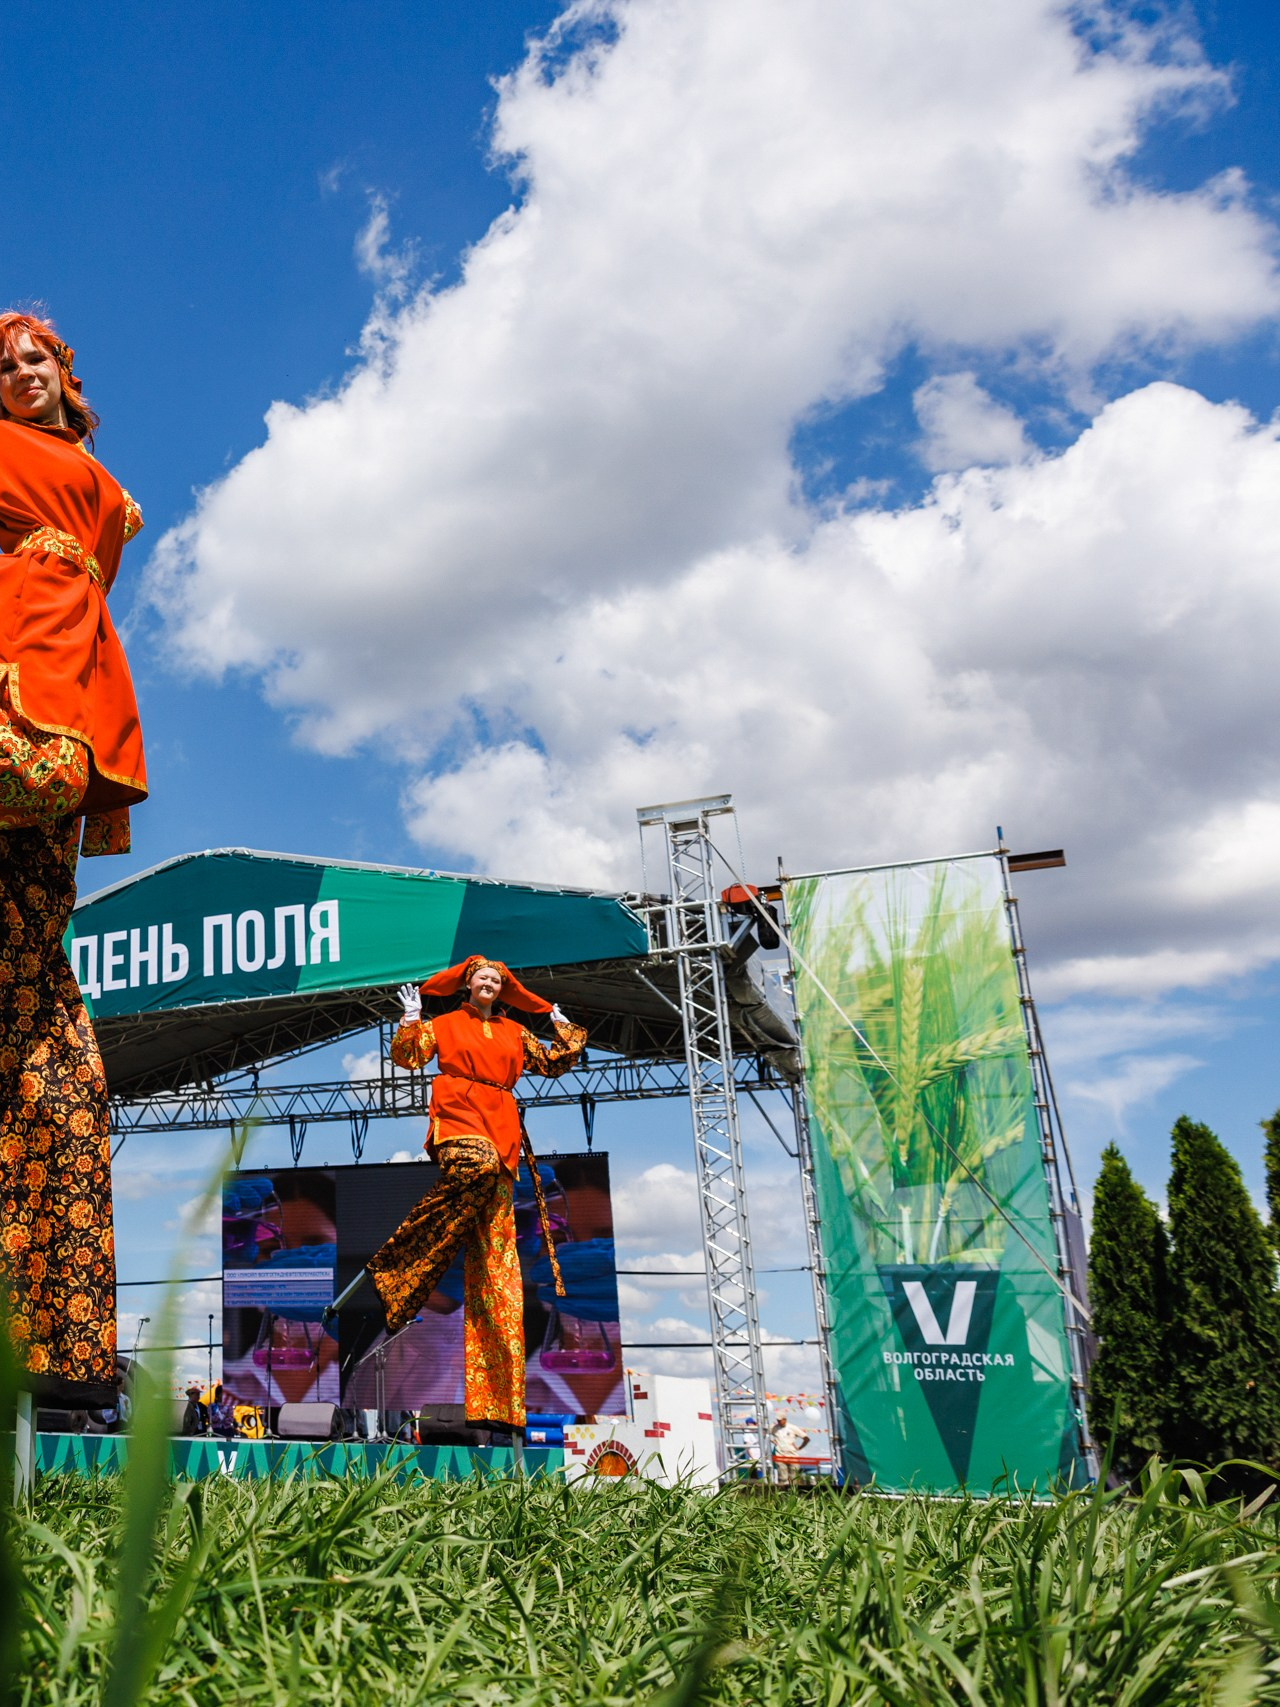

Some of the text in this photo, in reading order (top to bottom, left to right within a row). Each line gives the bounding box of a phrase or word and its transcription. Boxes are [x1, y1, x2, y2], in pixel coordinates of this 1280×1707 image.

[71, 899, 341, 1000] ДЕНЬ ПОЛЯ
[902, 1281, 977, 1345] V
[883, 1351, 1015, 1367] ВОЛГОГРАДСКАЯ
[914, 1367, 986, 1382] ОБЛАСТЬ
